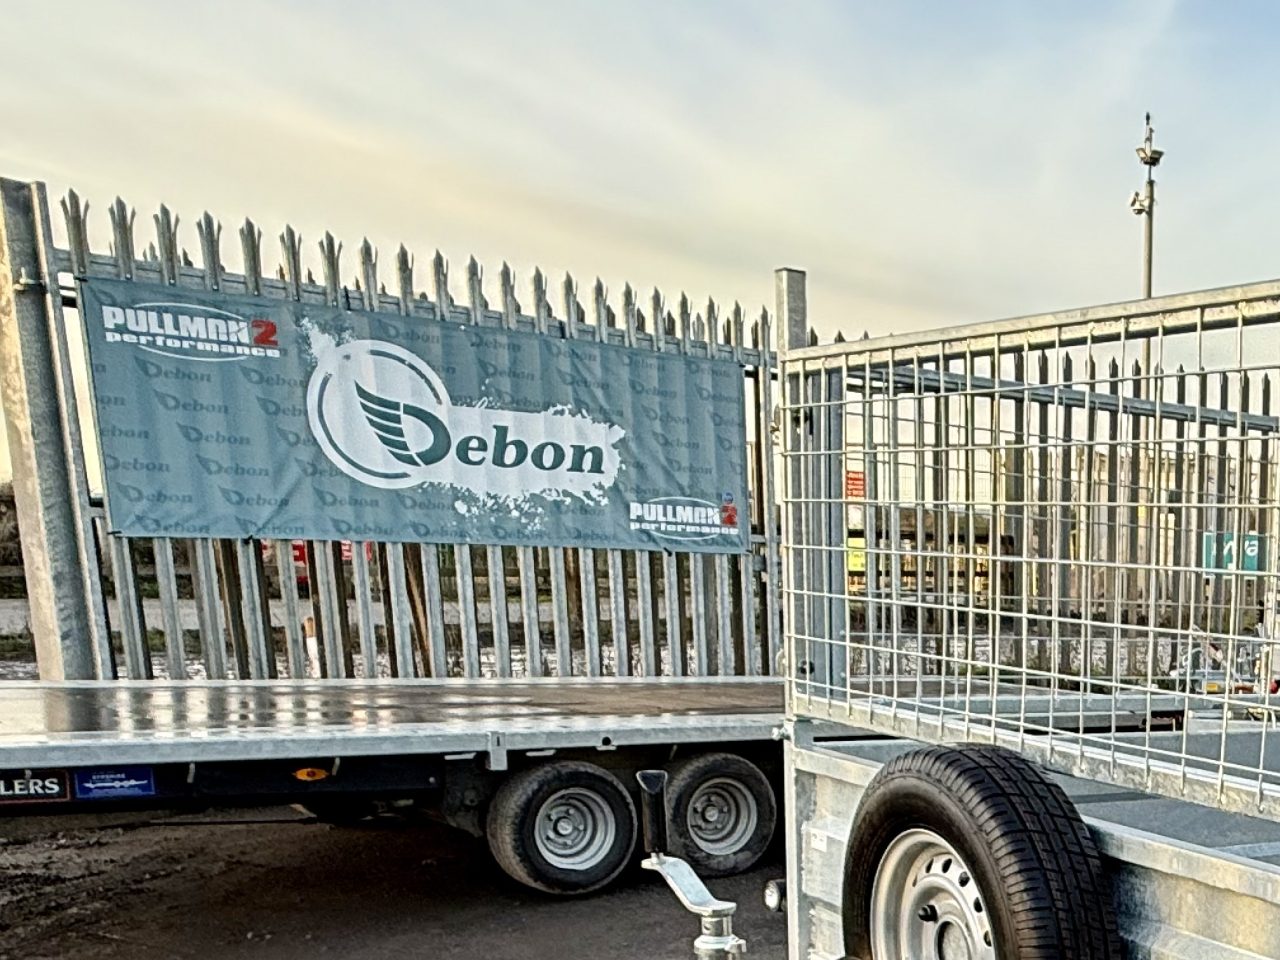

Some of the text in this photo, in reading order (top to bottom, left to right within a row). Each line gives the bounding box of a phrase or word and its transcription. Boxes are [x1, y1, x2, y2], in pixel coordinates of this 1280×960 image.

[105, 331, 281, 358] performance
[252, 319, 279, 347] 2
[135, 356, 212, 383] Debon
[152, 389, 230, 415] Debon
[176, 422, 250, 446] Debon
[354, 380, 605, 474] Debon
[196, 453, 270, 477] Debon
[629, 521, 740, 535] performance
